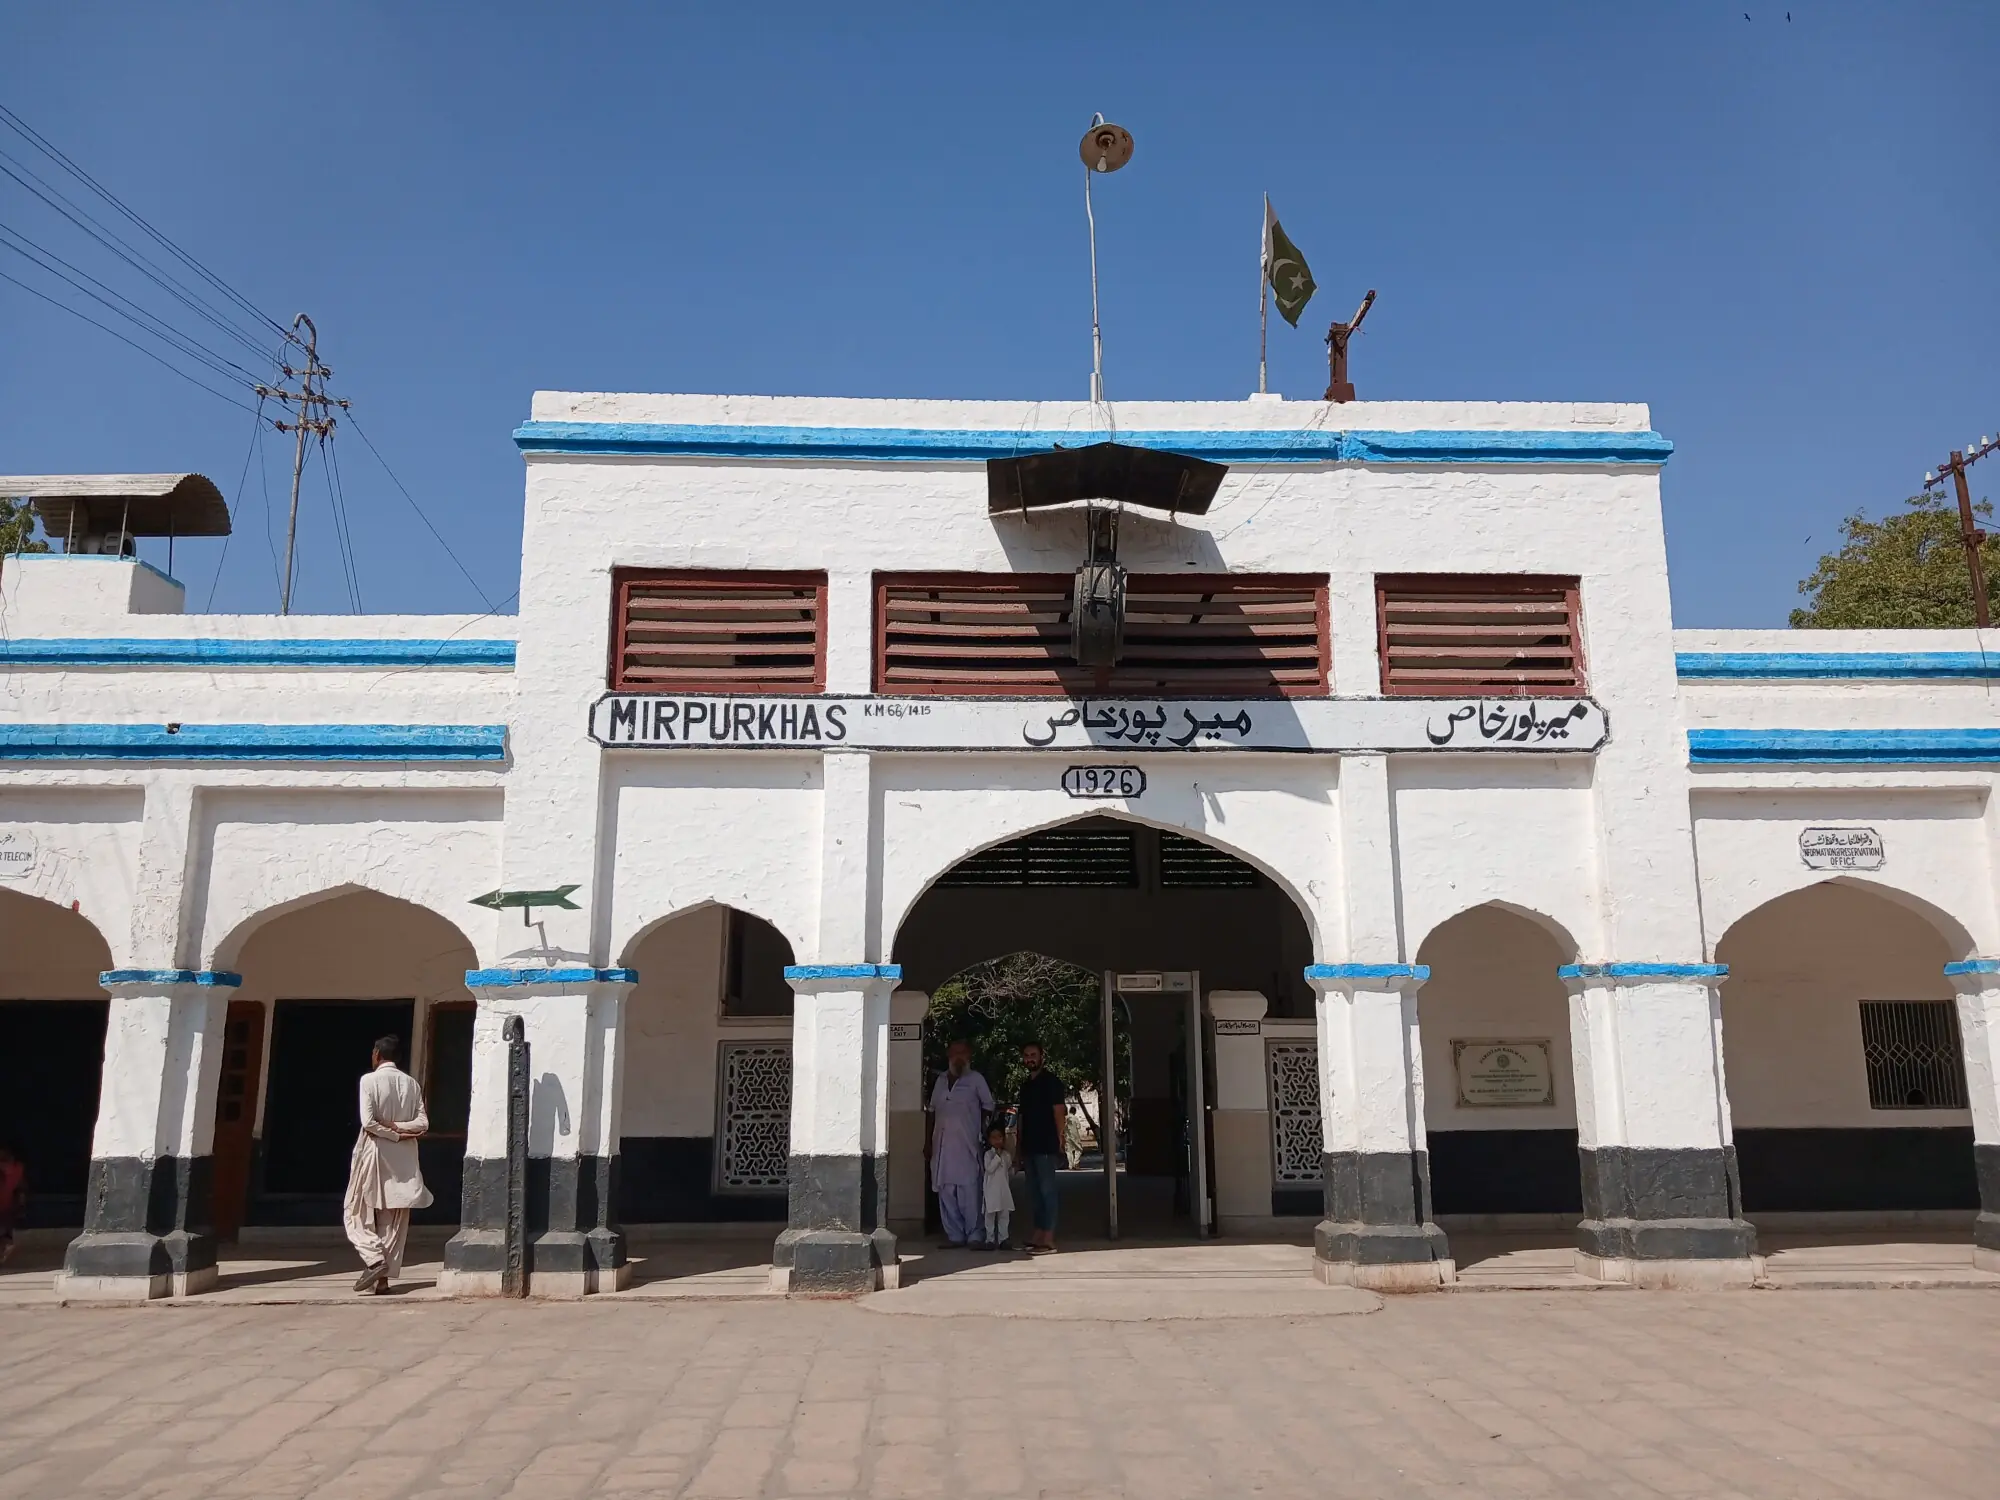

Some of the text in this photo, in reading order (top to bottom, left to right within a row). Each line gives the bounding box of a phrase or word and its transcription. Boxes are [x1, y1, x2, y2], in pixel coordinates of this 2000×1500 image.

[608, 699, 848, 741] MIRPURKHAS
[1076, 769, 1133, 794] 1926
[1830, 857, 1856, 865] OFFICE
